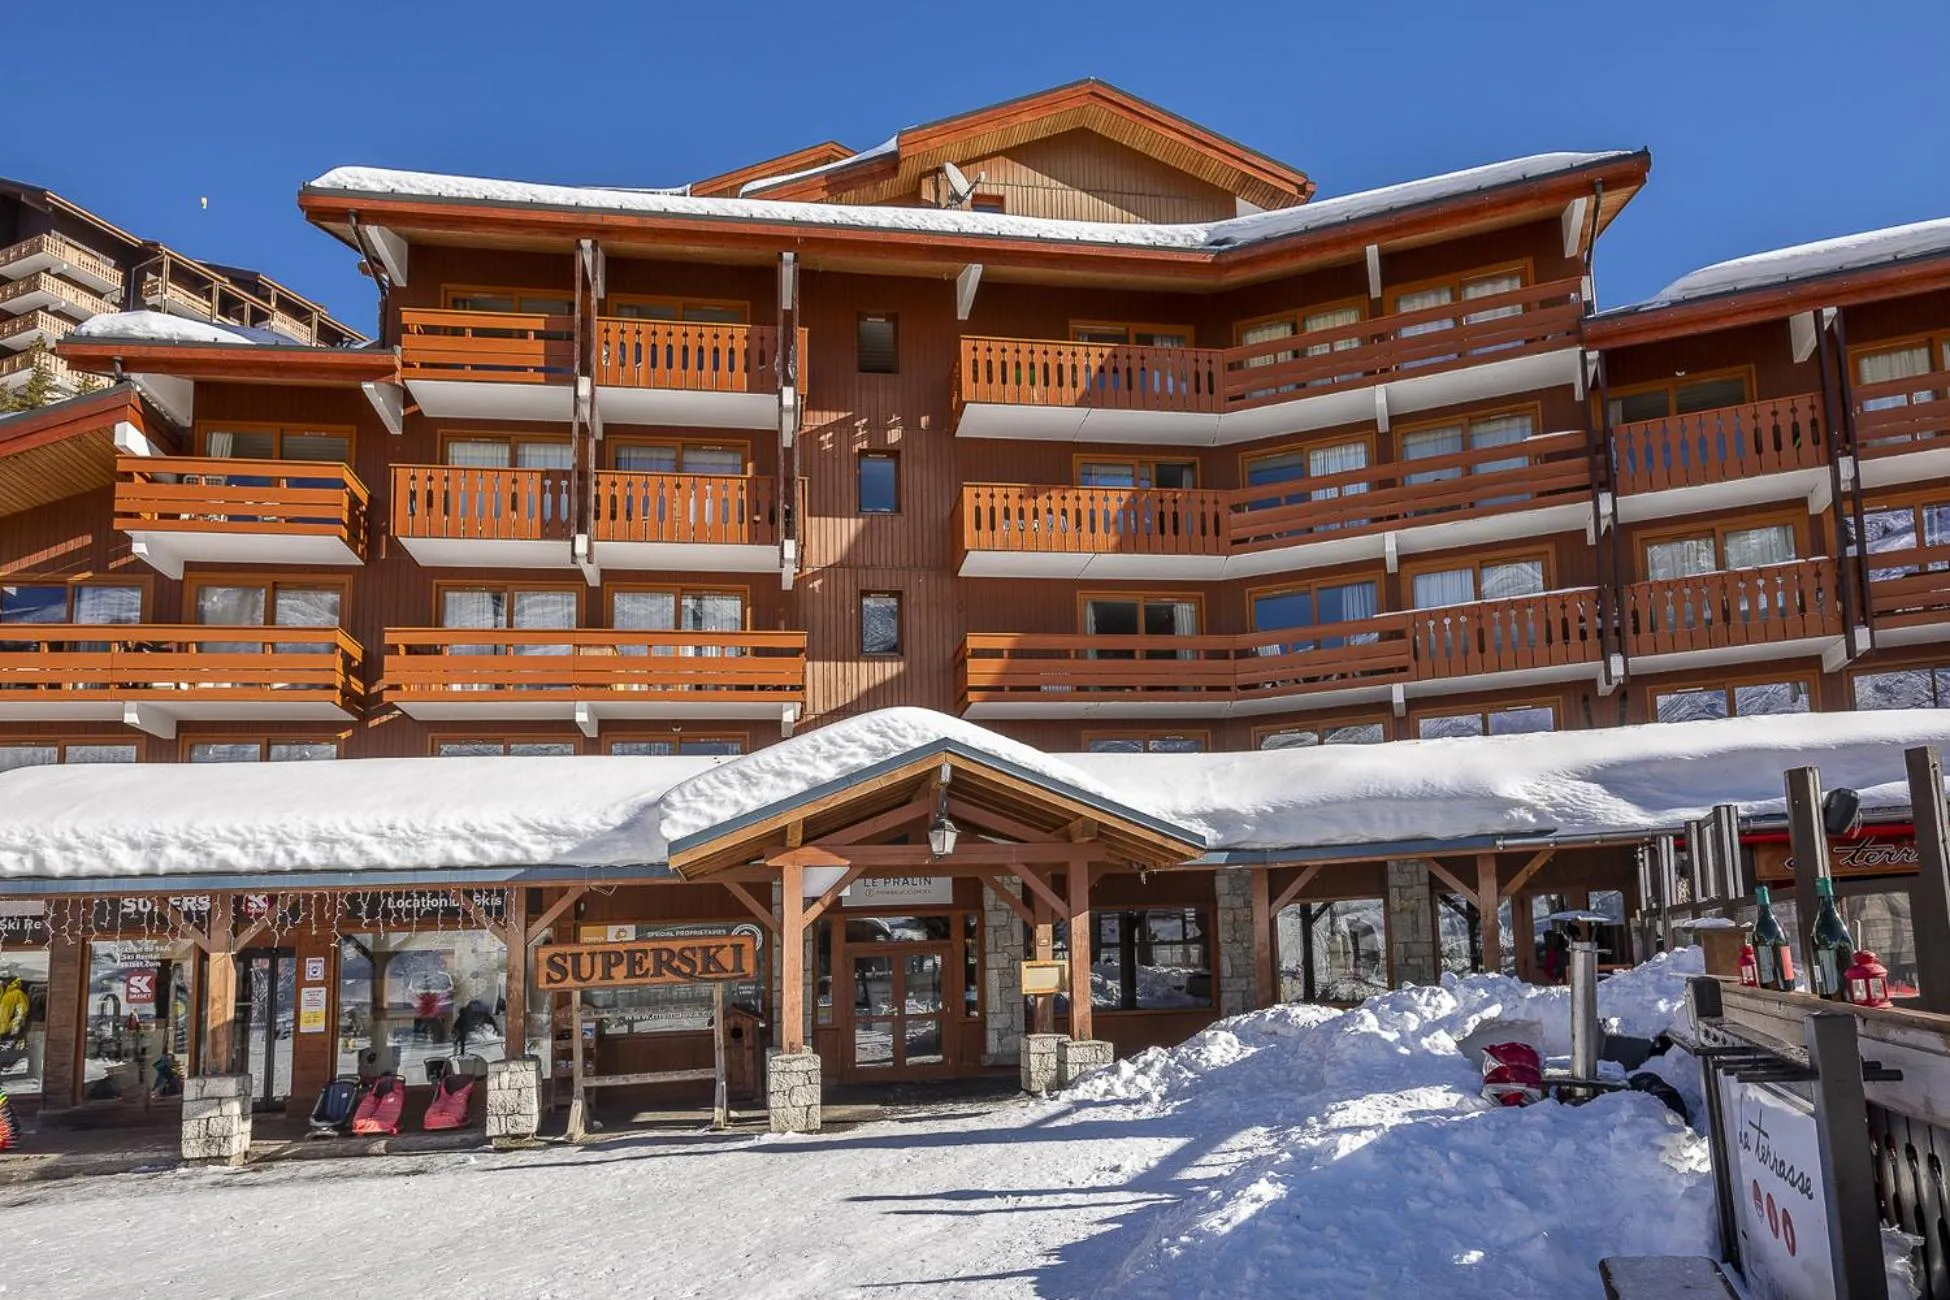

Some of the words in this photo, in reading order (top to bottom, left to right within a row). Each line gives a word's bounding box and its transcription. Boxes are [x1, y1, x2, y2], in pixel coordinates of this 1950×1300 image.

[883, 877, 932, 887] PRALIN
[387, 896, 448, 909] Location
[0, 918, 20, 930] Ski
[545, 943, 747, 985] SUPERSKI
